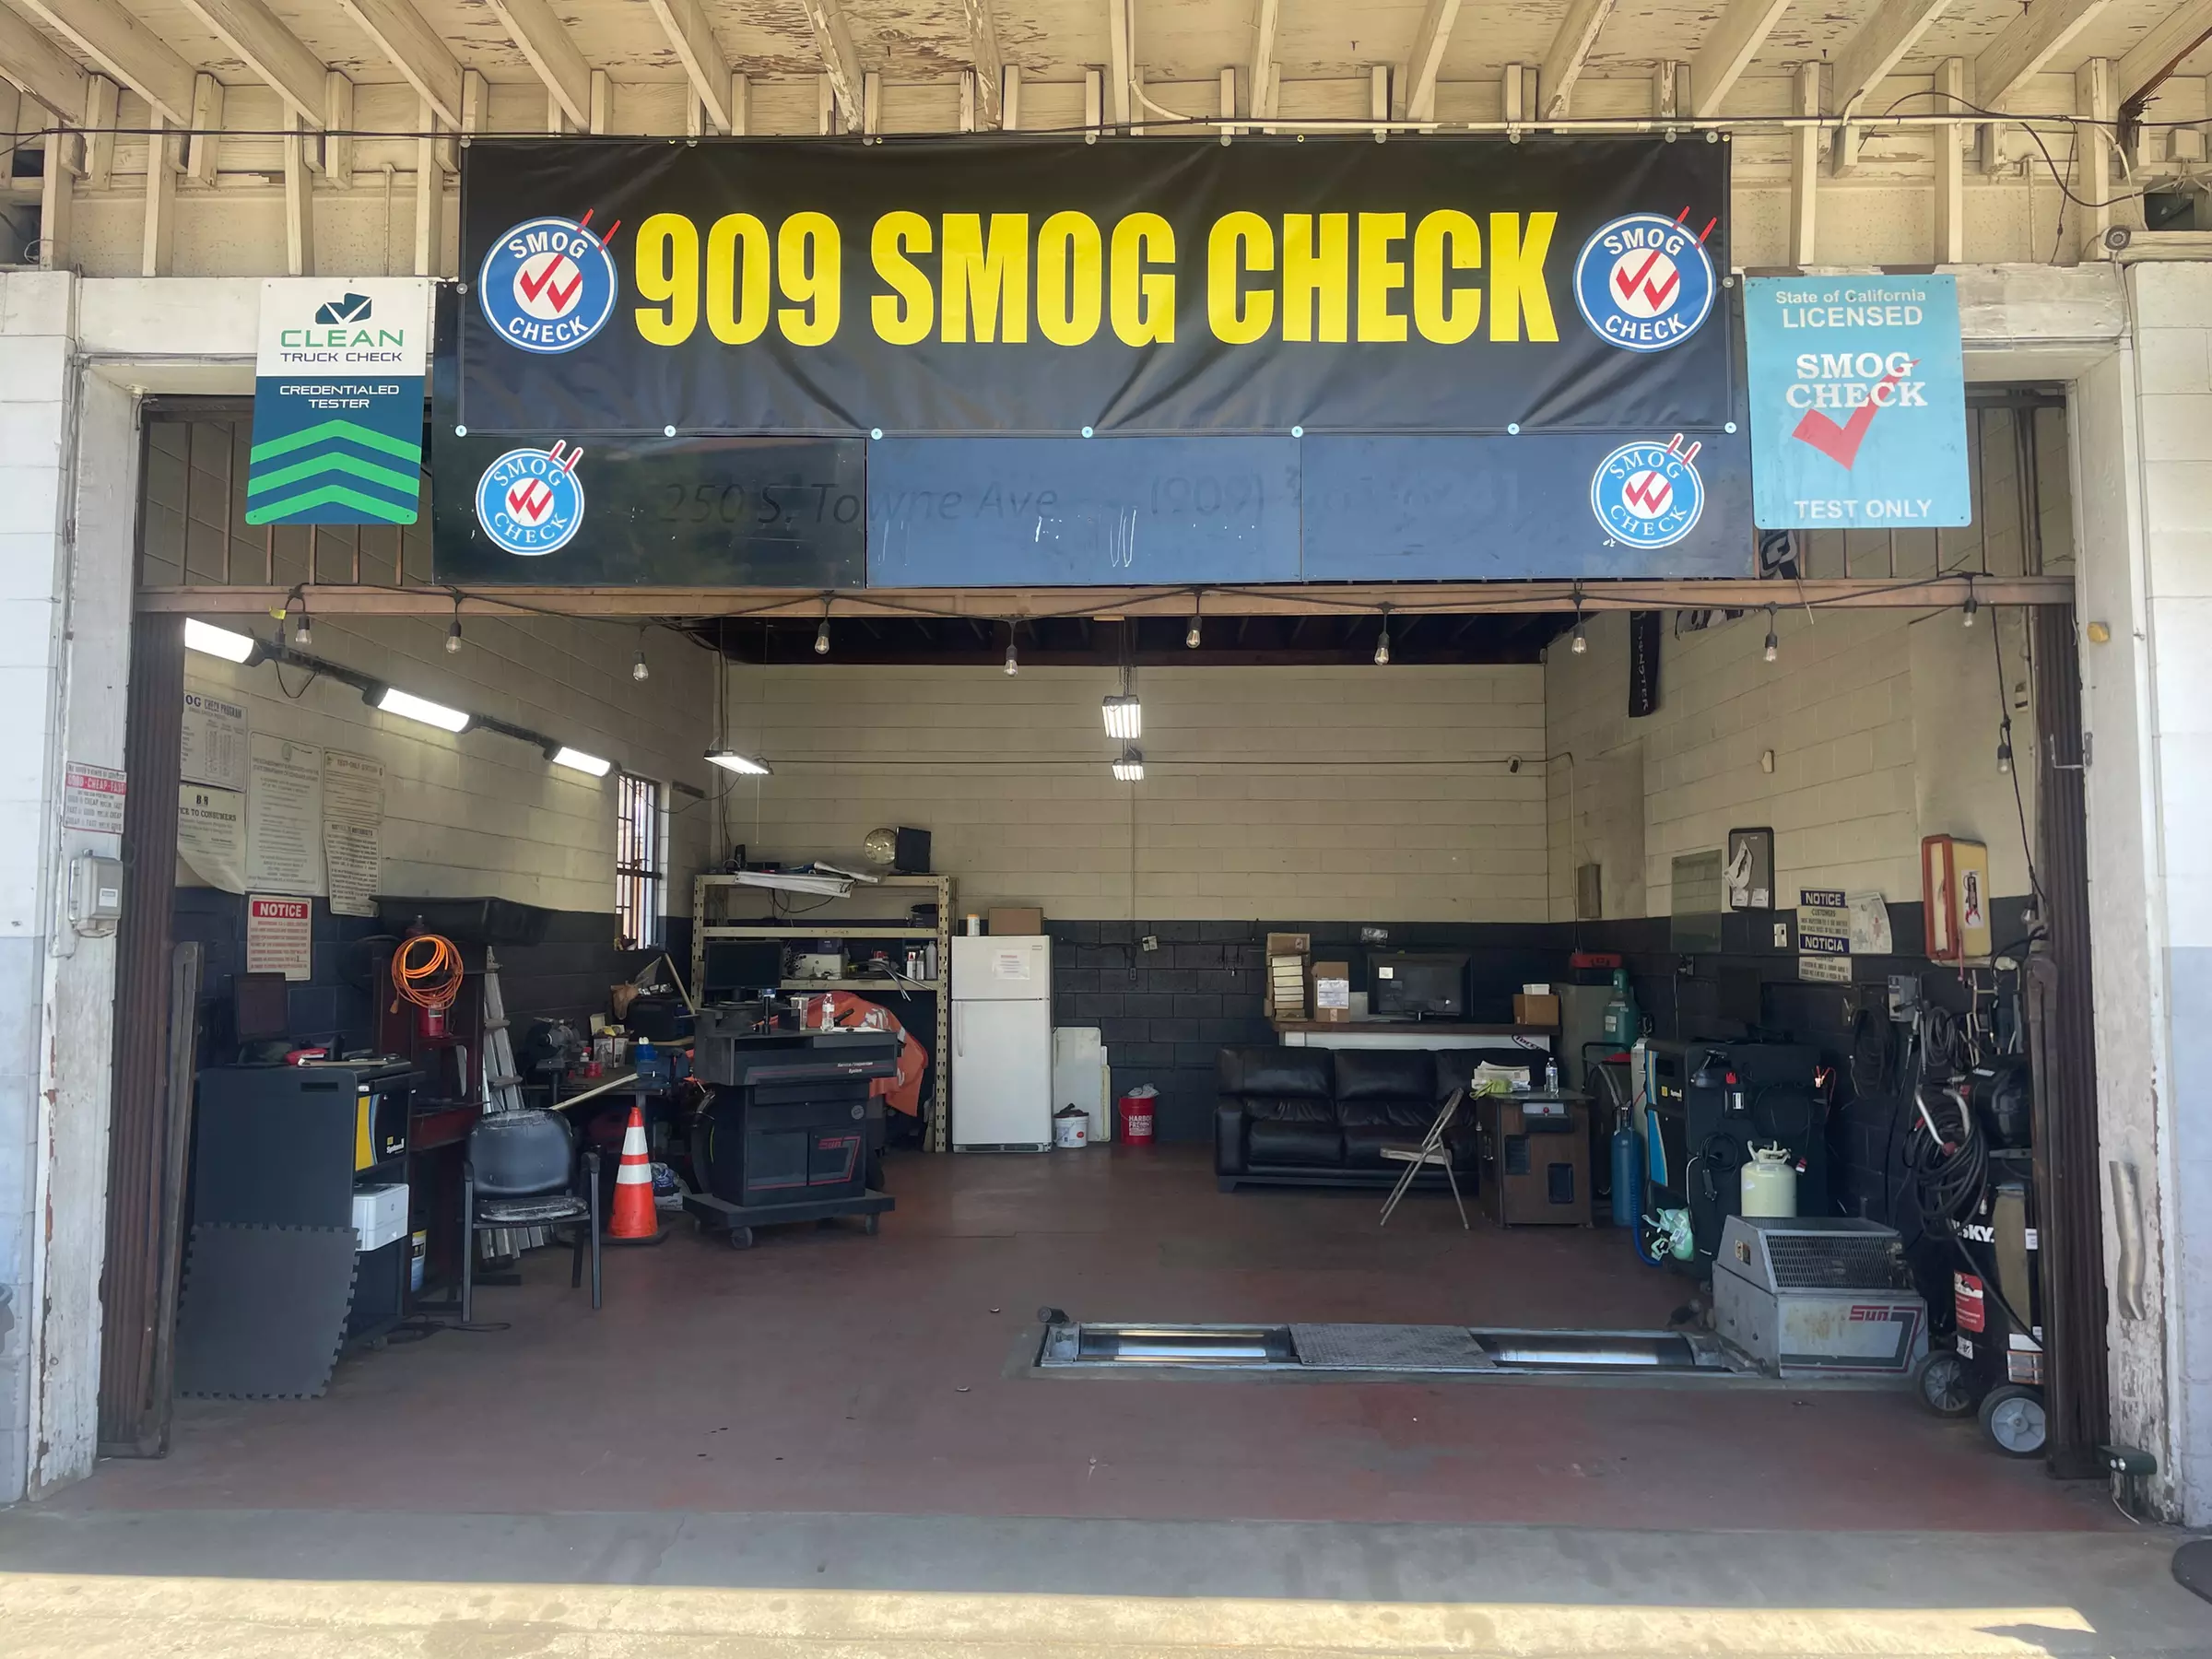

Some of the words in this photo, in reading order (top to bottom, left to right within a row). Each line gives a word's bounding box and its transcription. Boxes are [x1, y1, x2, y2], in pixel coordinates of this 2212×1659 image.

[508, 231, 589, 259] SMOG
[1603, 228, 1685, 256] SMOG
[635, 211, 841, 347] 909
[870, 211, 1176, 347] SMOG
[1207, 209, 1559, 345] CHECK
[1775, 290, 1818, 304] State
[1823, 289, 1841, 303] of
[1844, 288, 1926, 303] California
[508, 315, 589, 343] CHECK
[1605, 312, 1688, 340] CHECK
[1783, 306, 1924, 328] LICENSED
[280, 329, 405, 347] CLEAN
[280, 352, 339, 362] TRUCK
[346, 352, 403, 362] CHECK
[1796, 352, 1913, 379] SMOG
[279, 385, 400, 395] CREDENTIALED
[1785, 382, 1928, 408] CHECK
[308, 398, 370, 409] TESTER
[493, 458, 566, 487] SMOG
[1609, 451, 1685, 479] SMOG
[658, 483, 745, 524] 250
[811, 481, 962, 524] Towne
[974, 480, 1058, 521] Ave
[1794, 500, 1859, 519] TEST
[1865, 499, 1933, 519] ONLY
[494, 512, 569, 544] CHECK
[1610, 504, 1688, 535] CHECK
[183, 694, 201, 707] OG
[260, 903, 302, 917] NOTICE
[1806, 892, 1841, 906] NOTICE
[1805, 935, 1844, 952] NOTICIA
[1849, 1305, 1891, 1322] Sun
